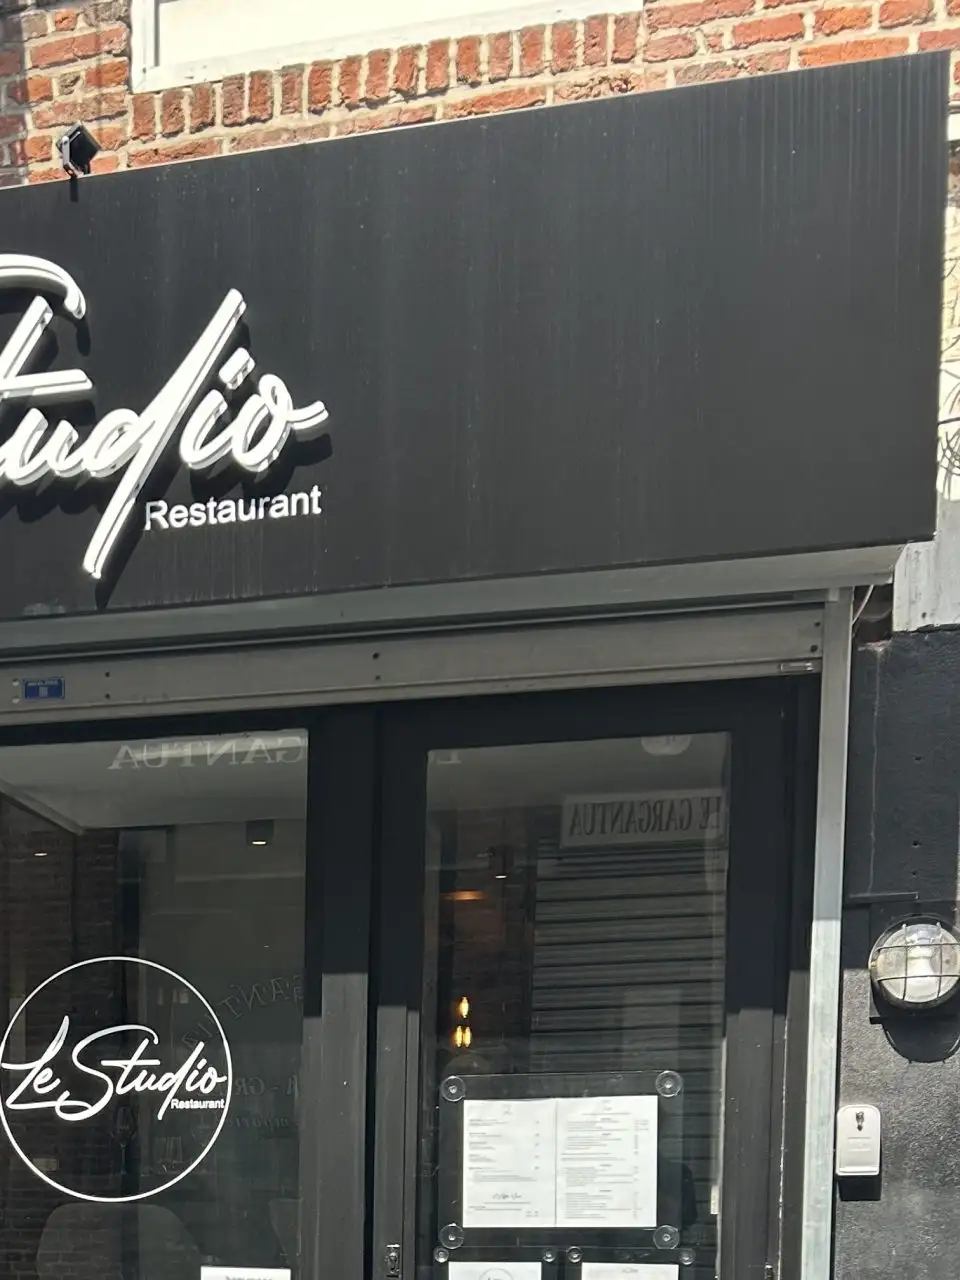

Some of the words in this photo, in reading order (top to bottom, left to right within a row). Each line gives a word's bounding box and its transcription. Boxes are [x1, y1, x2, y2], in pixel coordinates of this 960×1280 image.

[145, 486, 322, 531] Restaurant
[1, 1015, 70, 1110] Le
[55, 1024, 227, 1121] Studio
[170, 1098, 226, 1110] Restaurant
